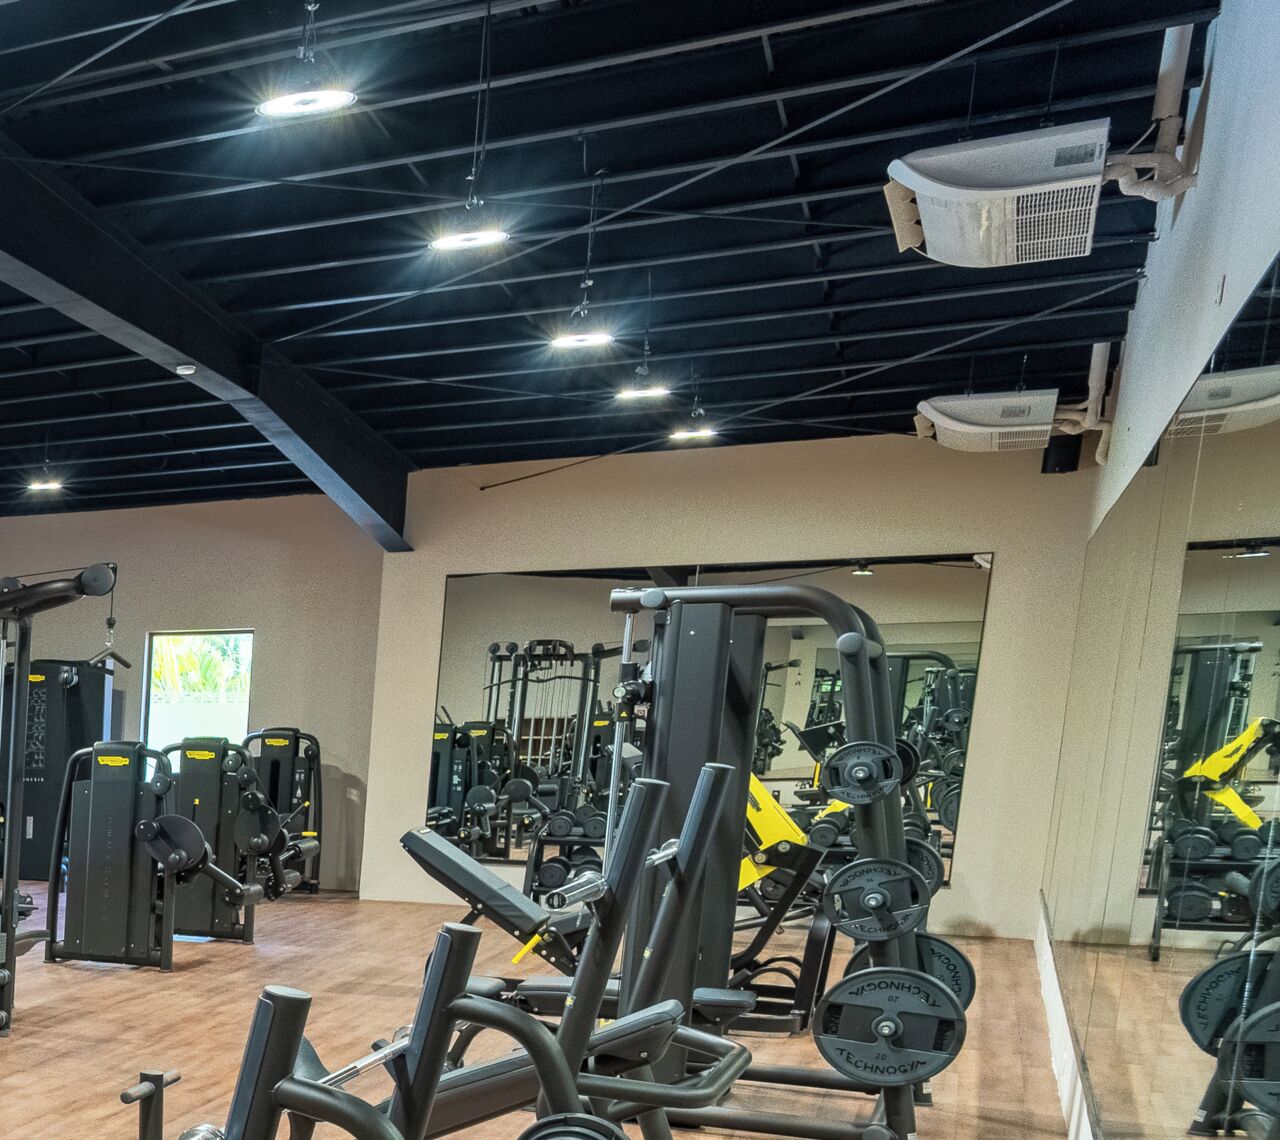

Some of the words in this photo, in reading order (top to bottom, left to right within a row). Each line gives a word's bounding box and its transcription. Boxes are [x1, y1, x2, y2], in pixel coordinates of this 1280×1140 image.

[840, 867, 900, 888] TECHNOGYM
[848, 980, 942, 1008] TECHNOGYM
[835, 1047, 928, 1075] TECHNOGYM
[874, 1053, 887, 1061] 20
